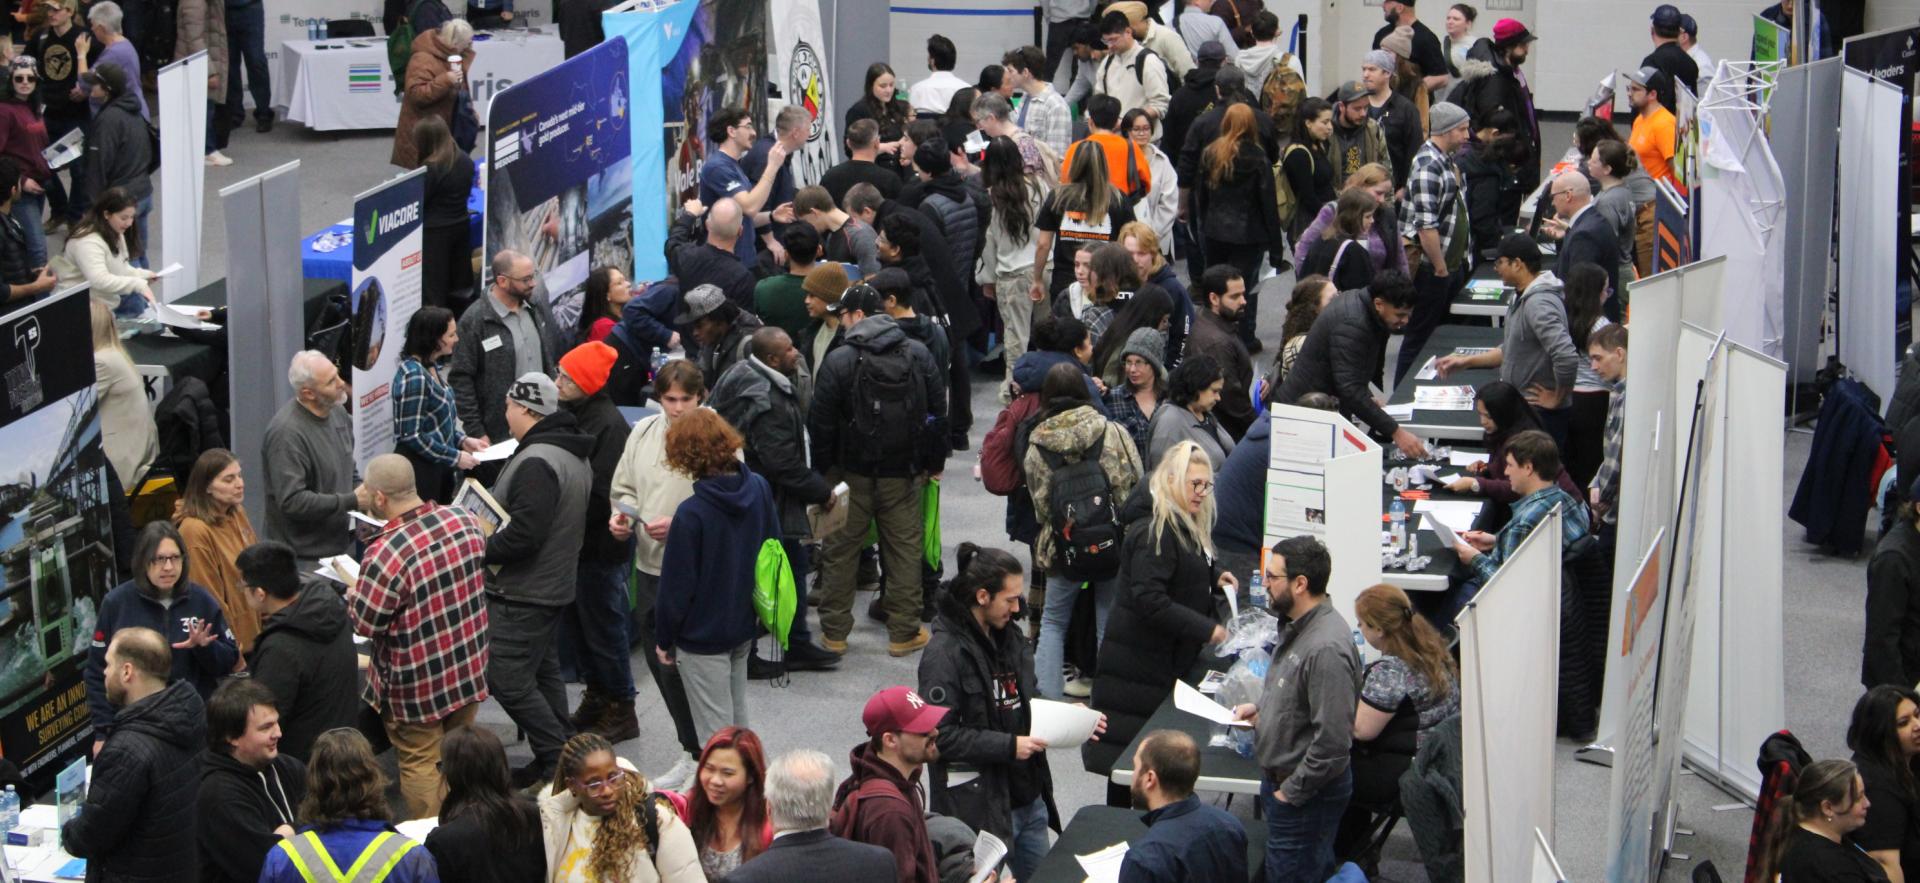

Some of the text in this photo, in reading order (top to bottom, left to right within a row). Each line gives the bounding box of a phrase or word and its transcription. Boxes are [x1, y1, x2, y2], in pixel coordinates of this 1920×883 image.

[1875, 65, 1904, 79] leaders
[539, 114, 559, 132] Canada's
[539, 130, 550, 147] gold
[674, 162, 694, 192] Vale
[379, 201, 420, 235] VIACORE
[25, 681, 87, 732] WE ARE AN INNO
[38, 711, 73, 744] SURVEYING
